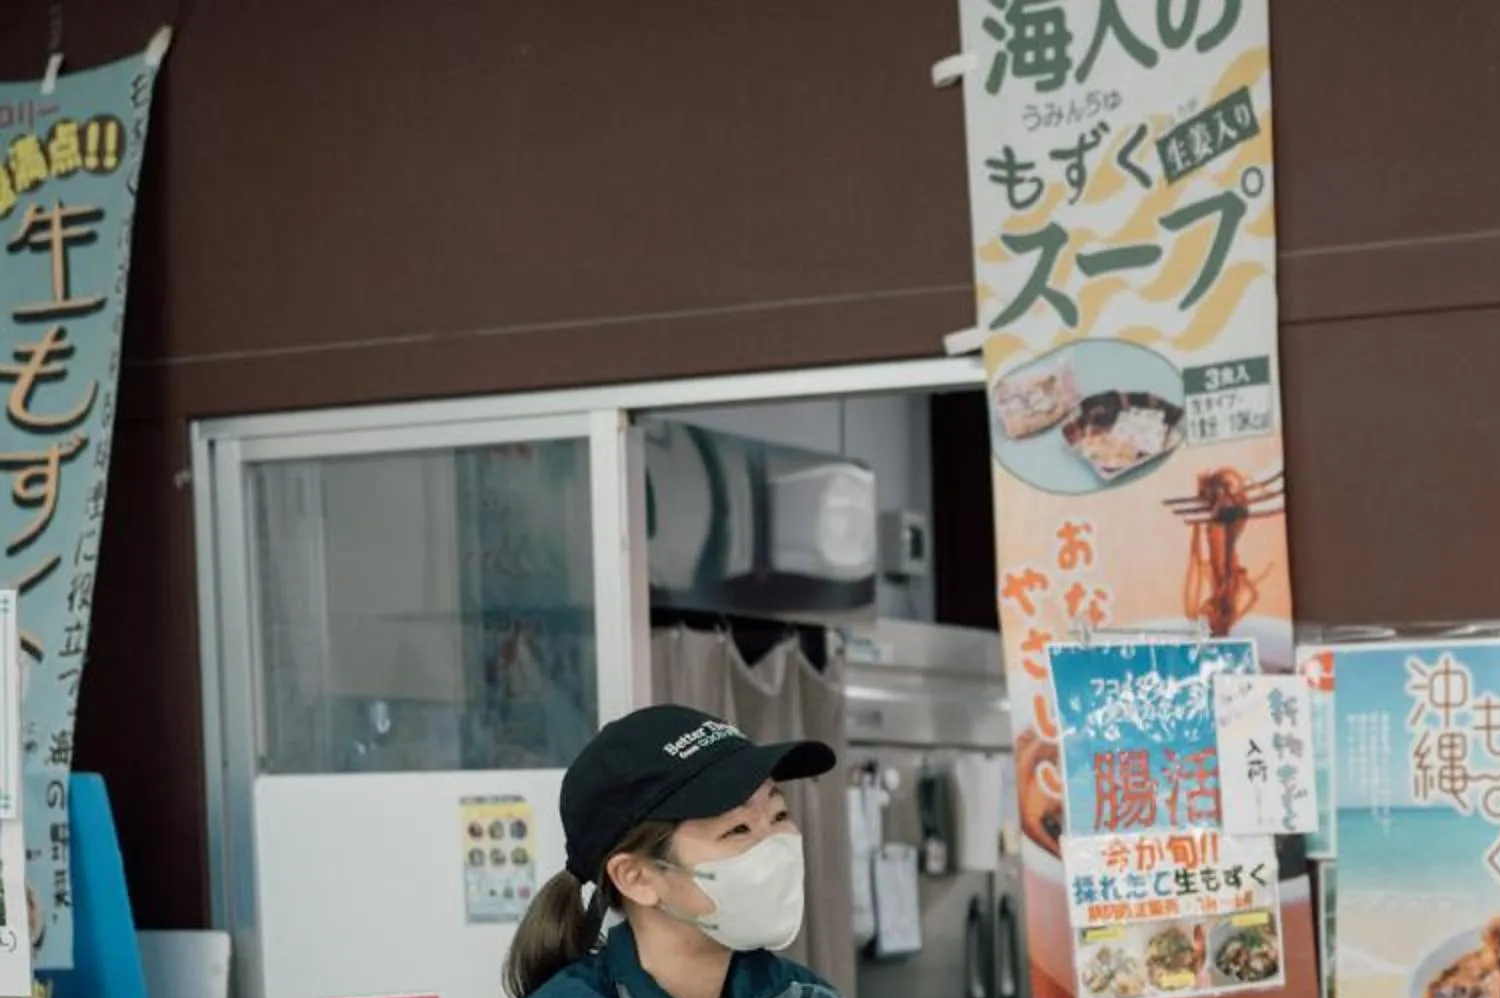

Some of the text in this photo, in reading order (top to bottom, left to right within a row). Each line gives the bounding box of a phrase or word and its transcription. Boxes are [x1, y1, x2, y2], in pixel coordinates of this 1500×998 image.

[985, 122, 1153, 210] もずく
[988, 165, 1265, 332] スープ
[1093, 745, 1222, 832] 腸活
[1410, 658, 1469, 810] 沖縄
